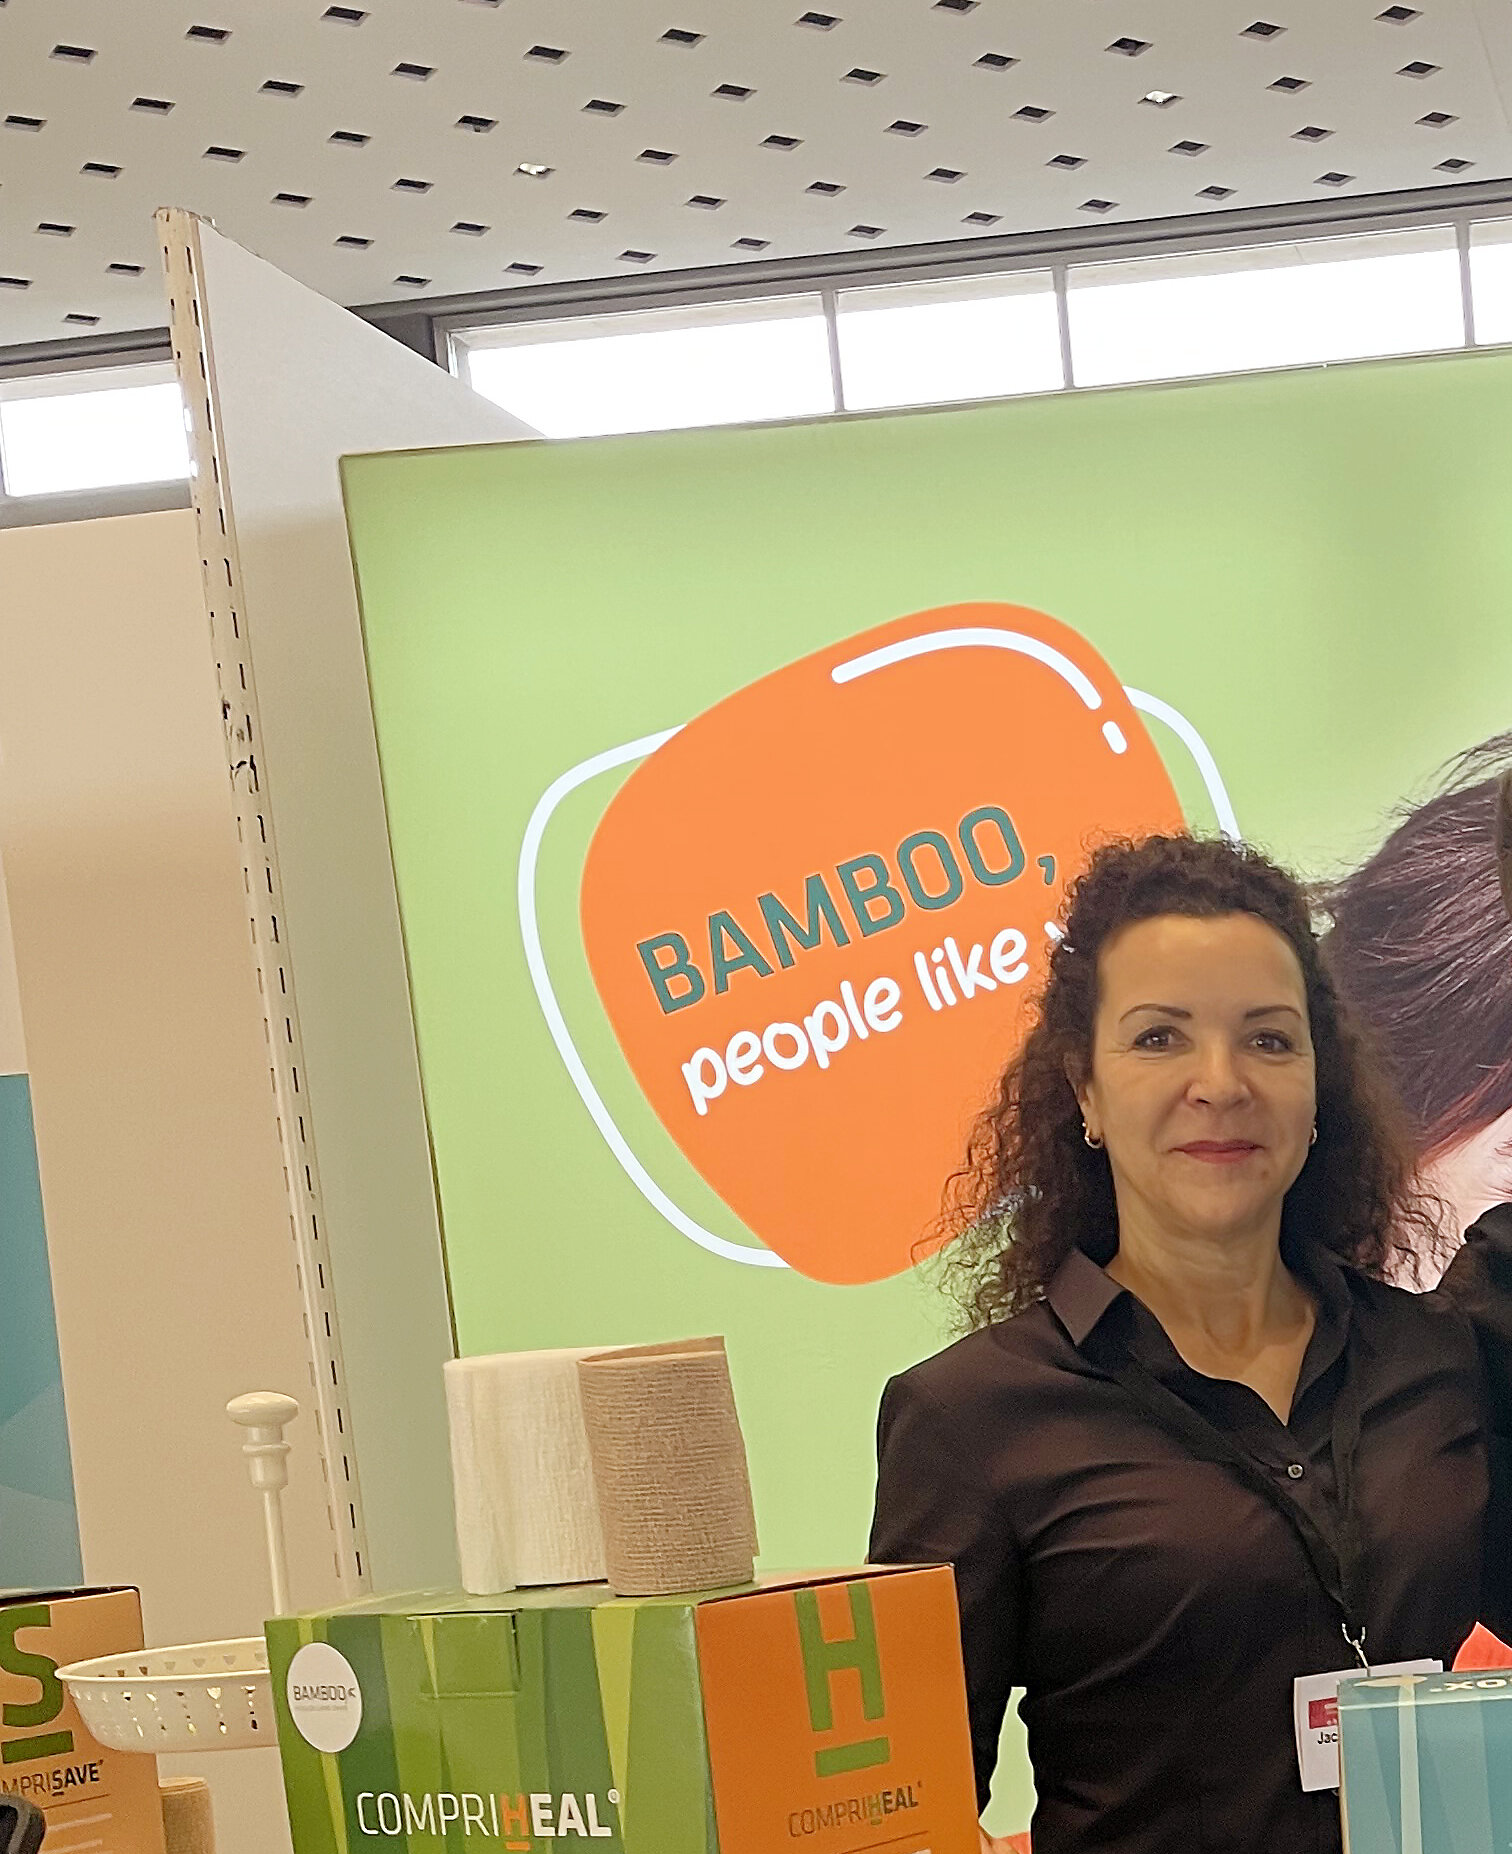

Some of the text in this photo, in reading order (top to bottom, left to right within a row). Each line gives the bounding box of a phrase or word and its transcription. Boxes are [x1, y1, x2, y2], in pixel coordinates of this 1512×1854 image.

[636, 806, 1056, 1015] BAMBOO,
[681, 926, 1029, 1116] people like
[793, 1580, 886, 1733] H
[1317, 1732, 1338, 1745] Jac
